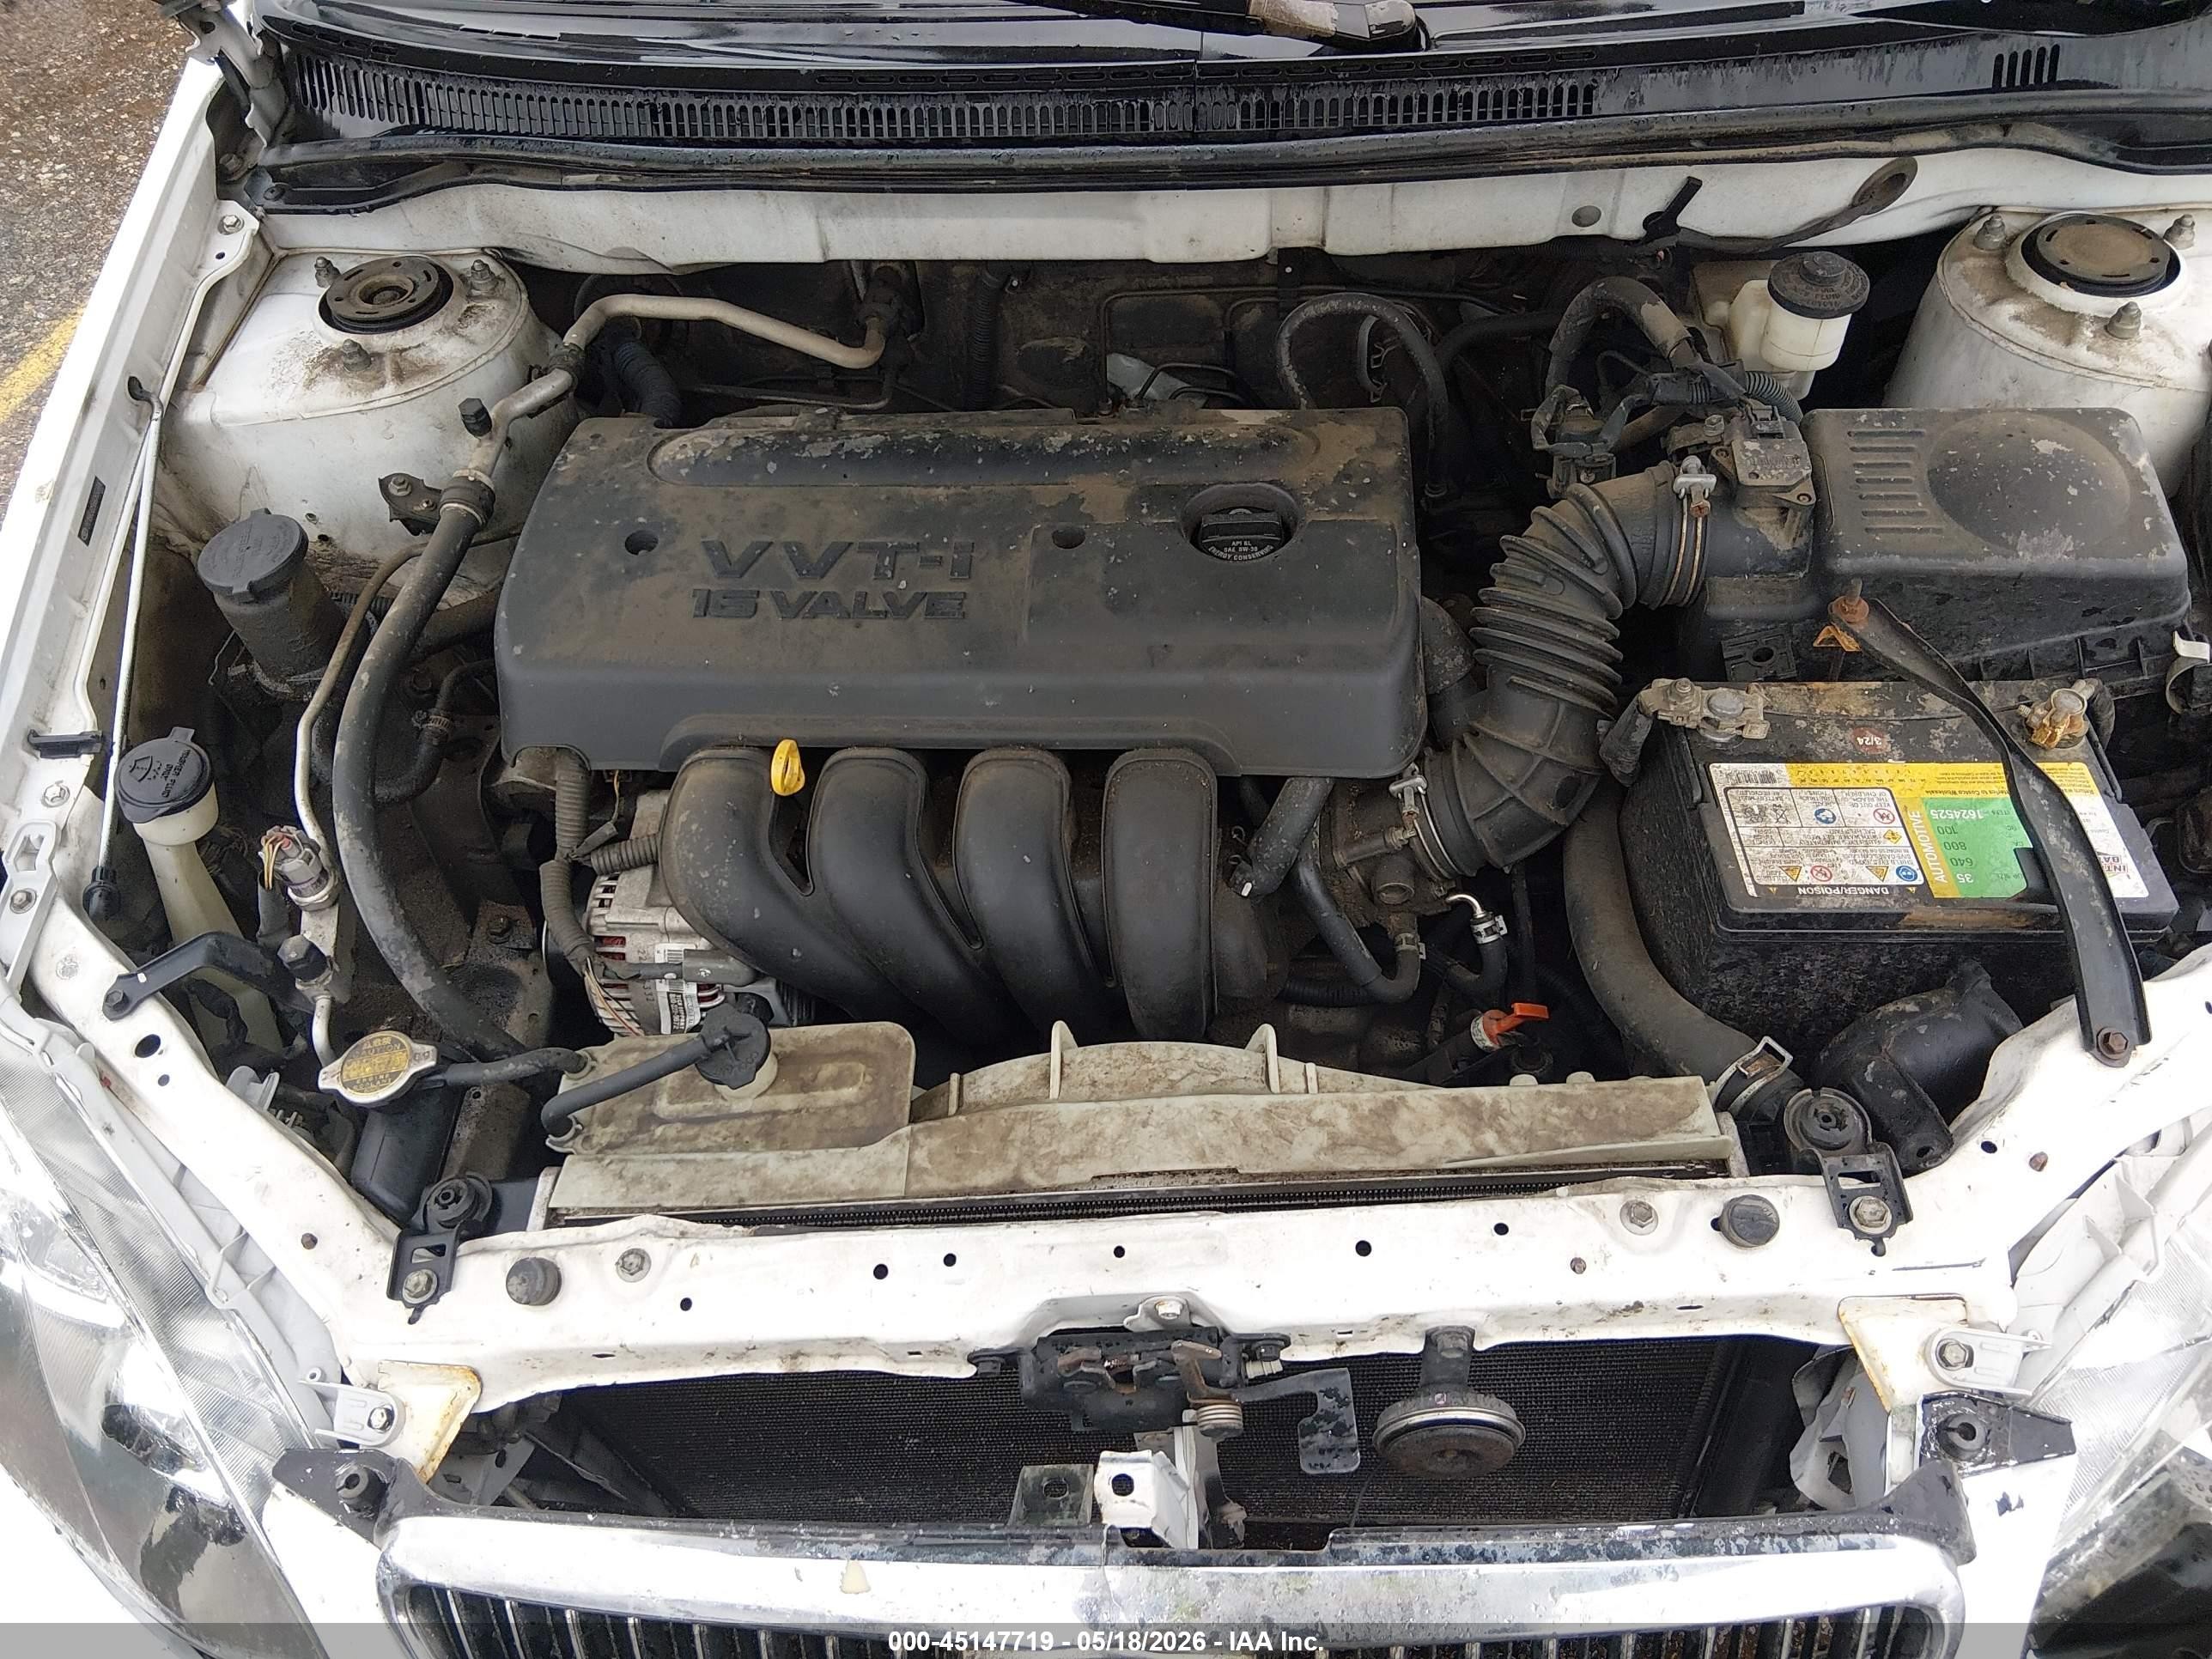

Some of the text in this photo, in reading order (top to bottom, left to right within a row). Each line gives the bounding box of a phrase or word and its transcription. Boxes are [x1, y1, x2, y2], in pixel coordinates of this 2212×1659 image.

[1208, 544, 1274, 561] ENERGY CONSERVING
[692, 588, 968, 620] 16 VALVE
[1856, 735, 1882, 745] 3/24
[1929, 809, 1984, 819] 1624525
[1907, 810, 1948, 884] AUTOMOTIVE
[1943, 842, 1966, 850] 800
[1950, 857, 1973, 866] 640
[1956, 873, 1974, 884] 35
[1796, 885, 1889, 896] DANGER/POISON
